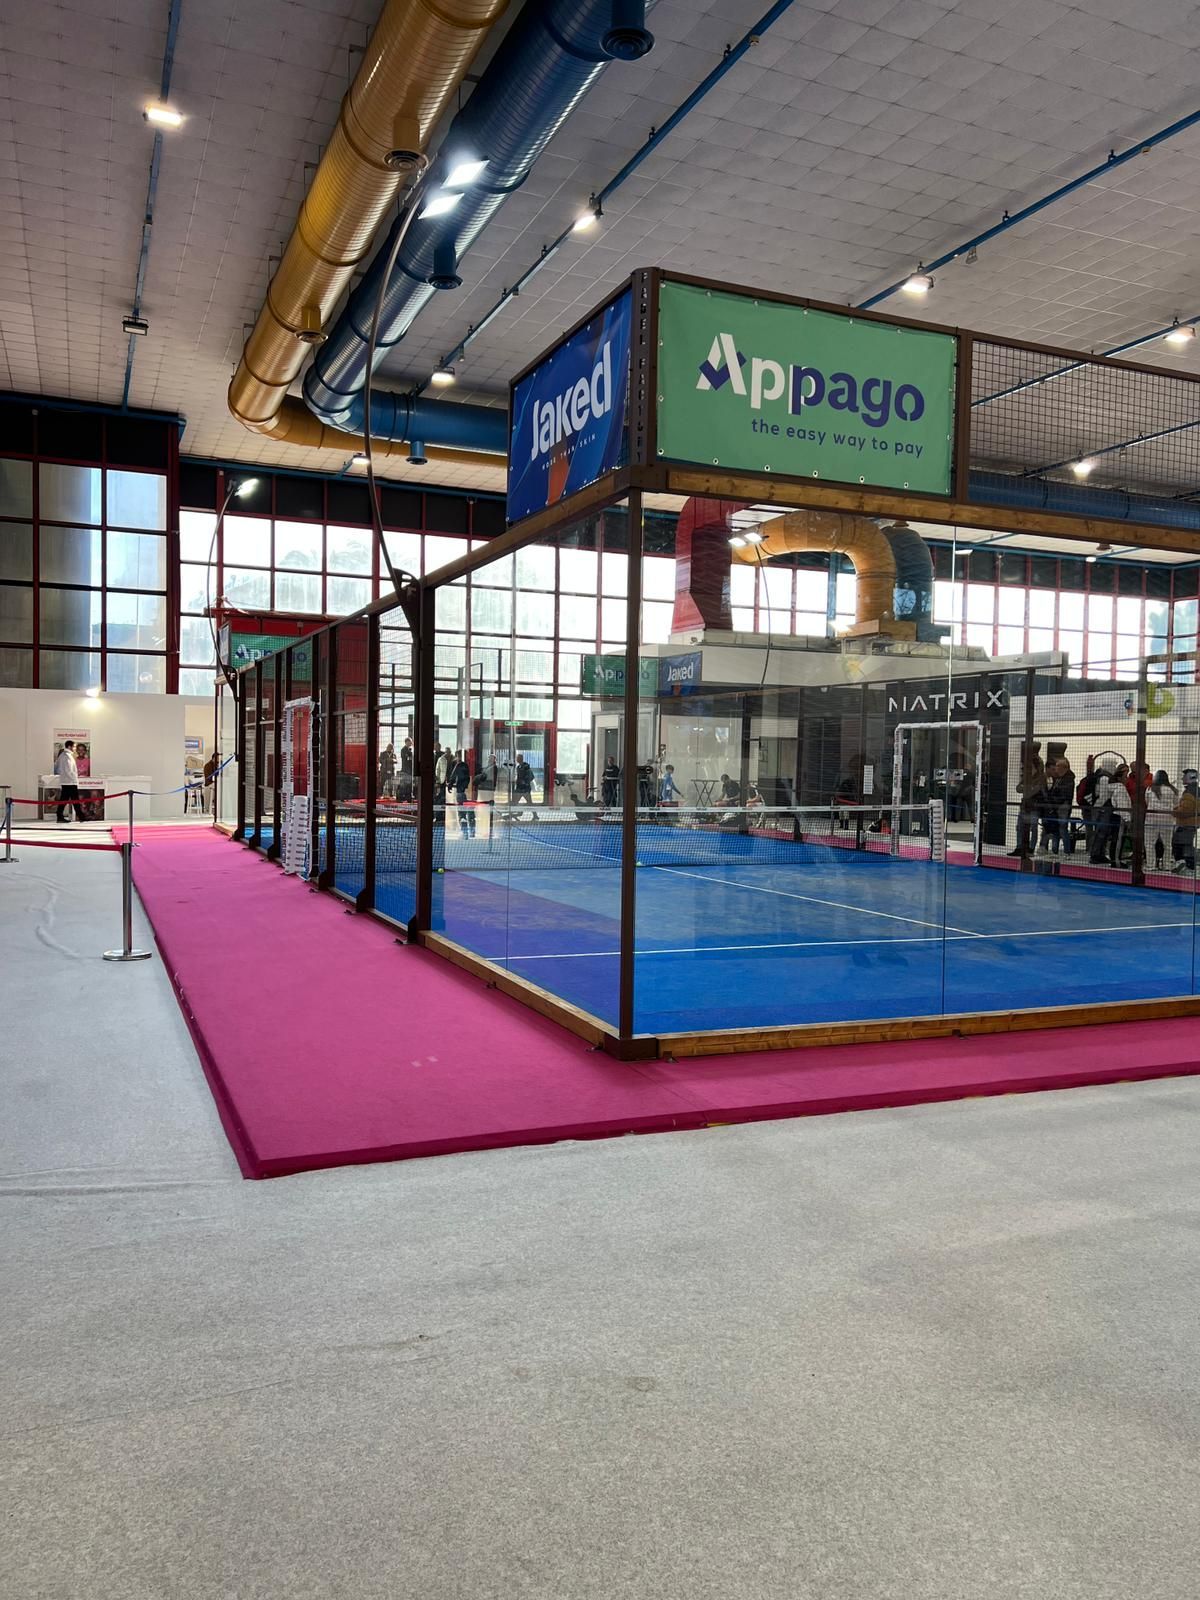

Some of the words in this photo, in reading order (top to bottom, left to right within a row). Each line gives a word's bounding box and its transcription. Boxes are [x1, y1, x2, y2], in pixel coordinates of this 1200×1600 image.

[531, 341, 612, 461] Jaked
[696, 332, 925, 428] Appago
[751, 418, 780, 435] the
[786, 427, 827, 445] easy
[833, 433, 867, 450] way
[872, 437, 889, 451] to
[894, 441, 924, 458] pay
[667, 662, 694, 681] Jaked
